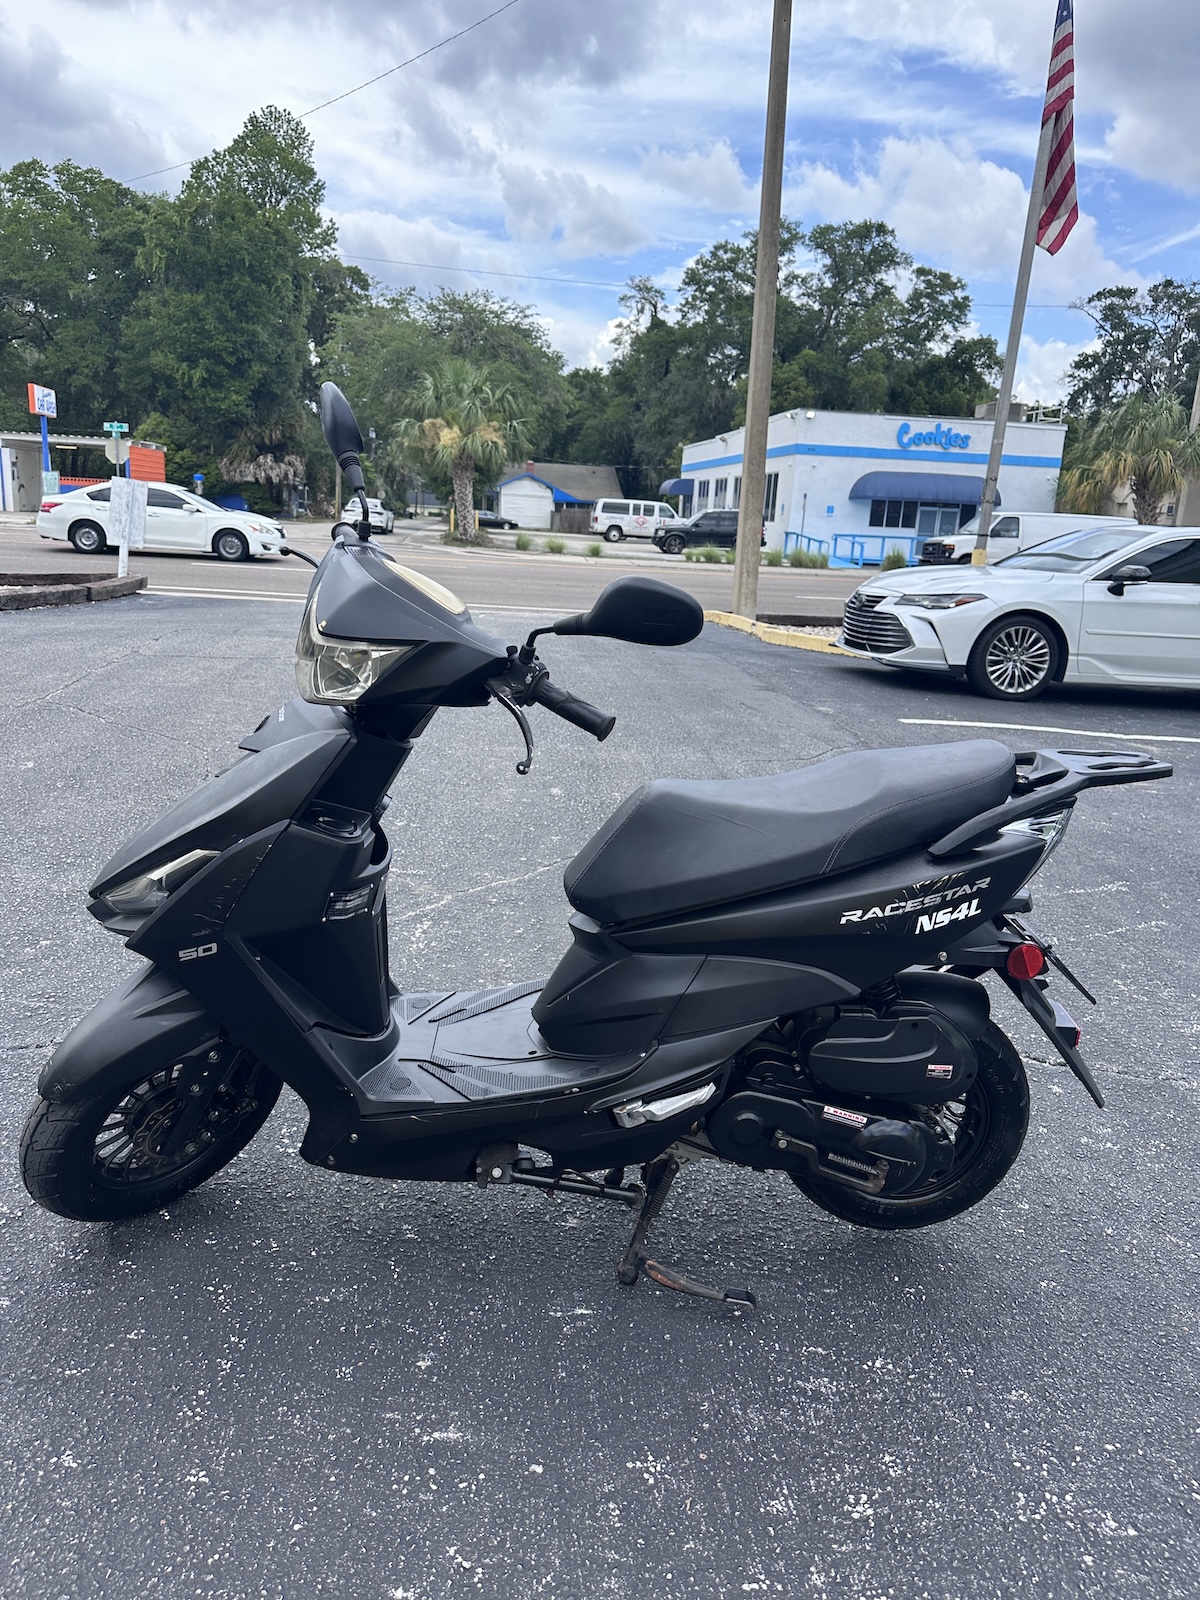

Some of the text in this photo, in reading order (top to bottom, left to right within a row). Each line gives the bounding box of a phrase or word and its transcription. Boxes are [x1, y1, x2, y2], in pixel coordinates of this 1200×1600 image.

[897, 422, 971, 450] Cookies
[839, 877, 992, 925] RACESTAR
[914, 898, 982, 935] NS4L
[178, 942, 218, 961] 50
[833, 1109, 865, 1122] WARNING
